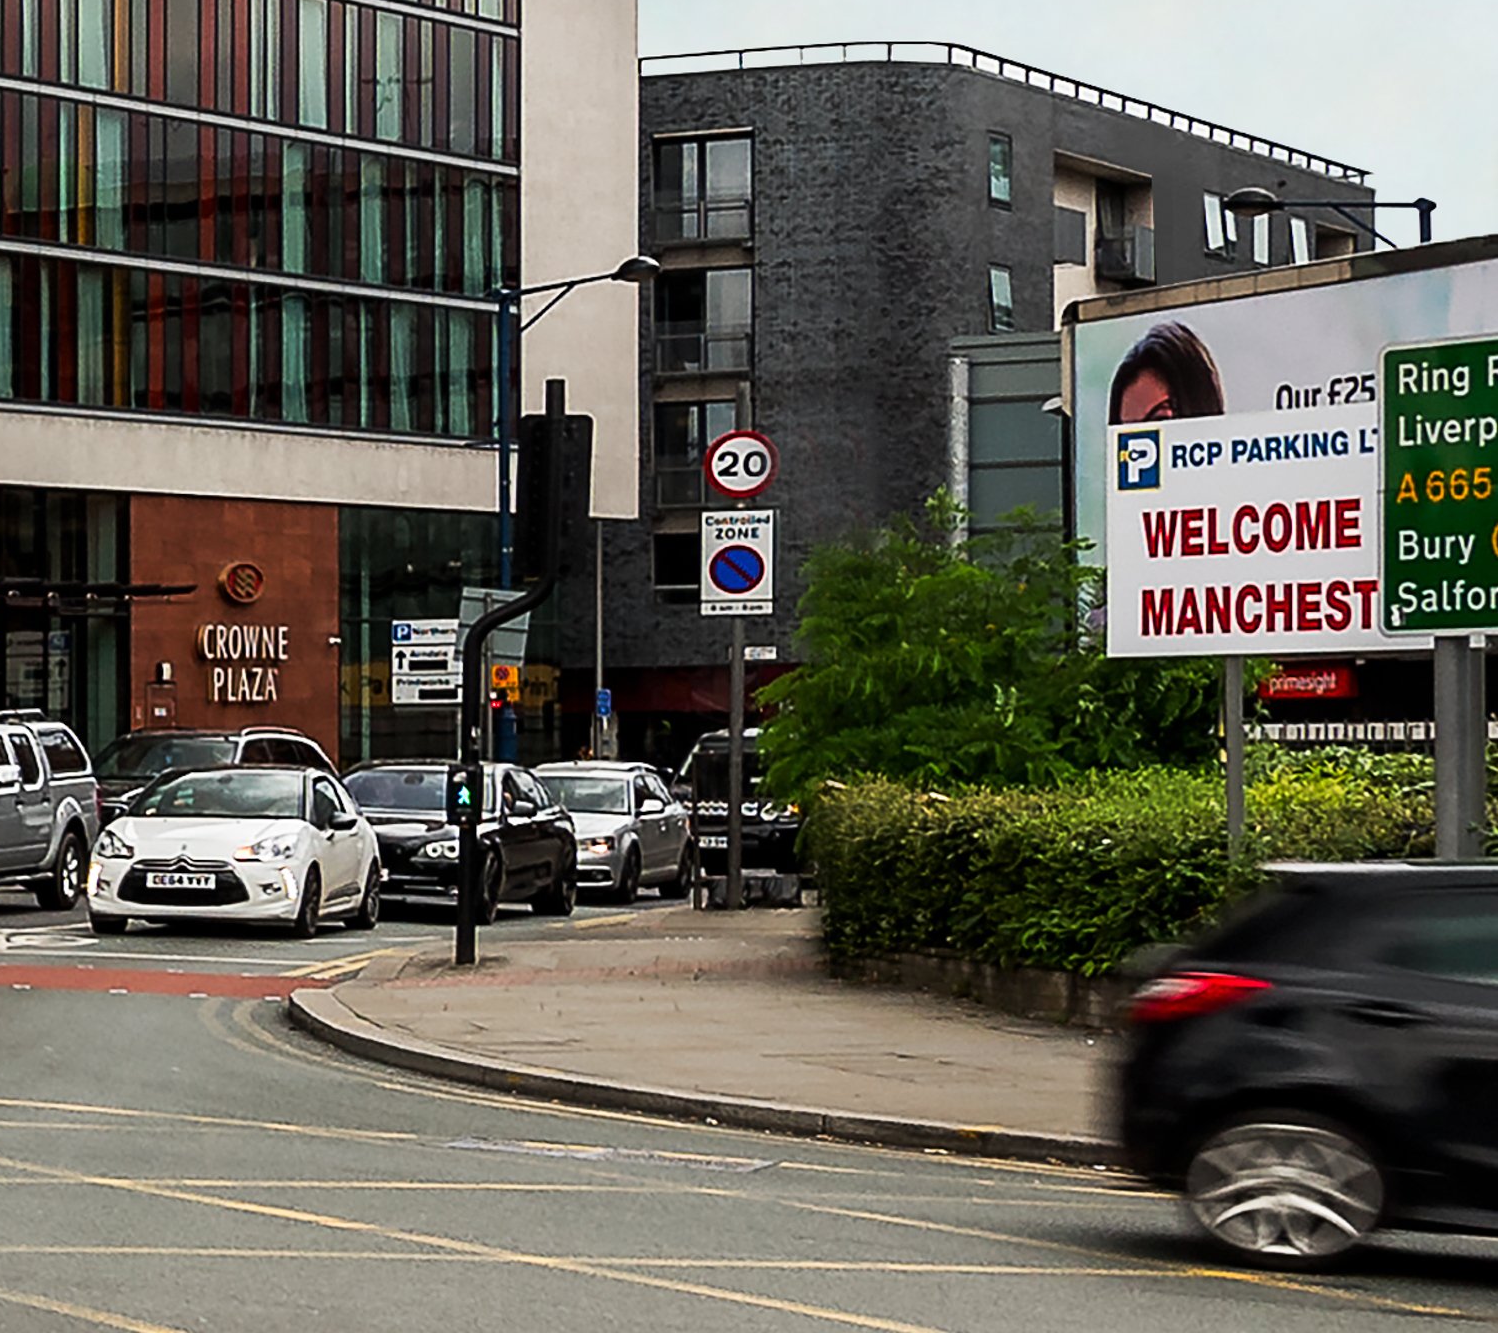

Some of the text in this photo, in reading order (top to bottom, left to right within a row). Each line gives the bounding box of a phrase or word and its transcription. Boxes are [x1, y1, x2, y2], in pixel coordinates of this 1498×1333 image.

[1398, 361, 1470, 397] Ring
[1276, 383, 1322, 411] Our
[1171, 442, 1222, 468] RCP
[1231, 429, 1349, 465] PARKING
[1398, 414, 1498, 448] Liverp
[716, 450, 769, 478] 20
[714, 527, 760, 540] ZONE
[1142, 497, 1362, 559] WELCOME
[1398, 529, 1476, 565] Bury
[1140, 578, 1379, 637] MANCHEST
[202, 624, 289, 660] CROWNE
[213, 667, 278, 702] PLAZA
[1268, 671, 1337, 695] primesight
